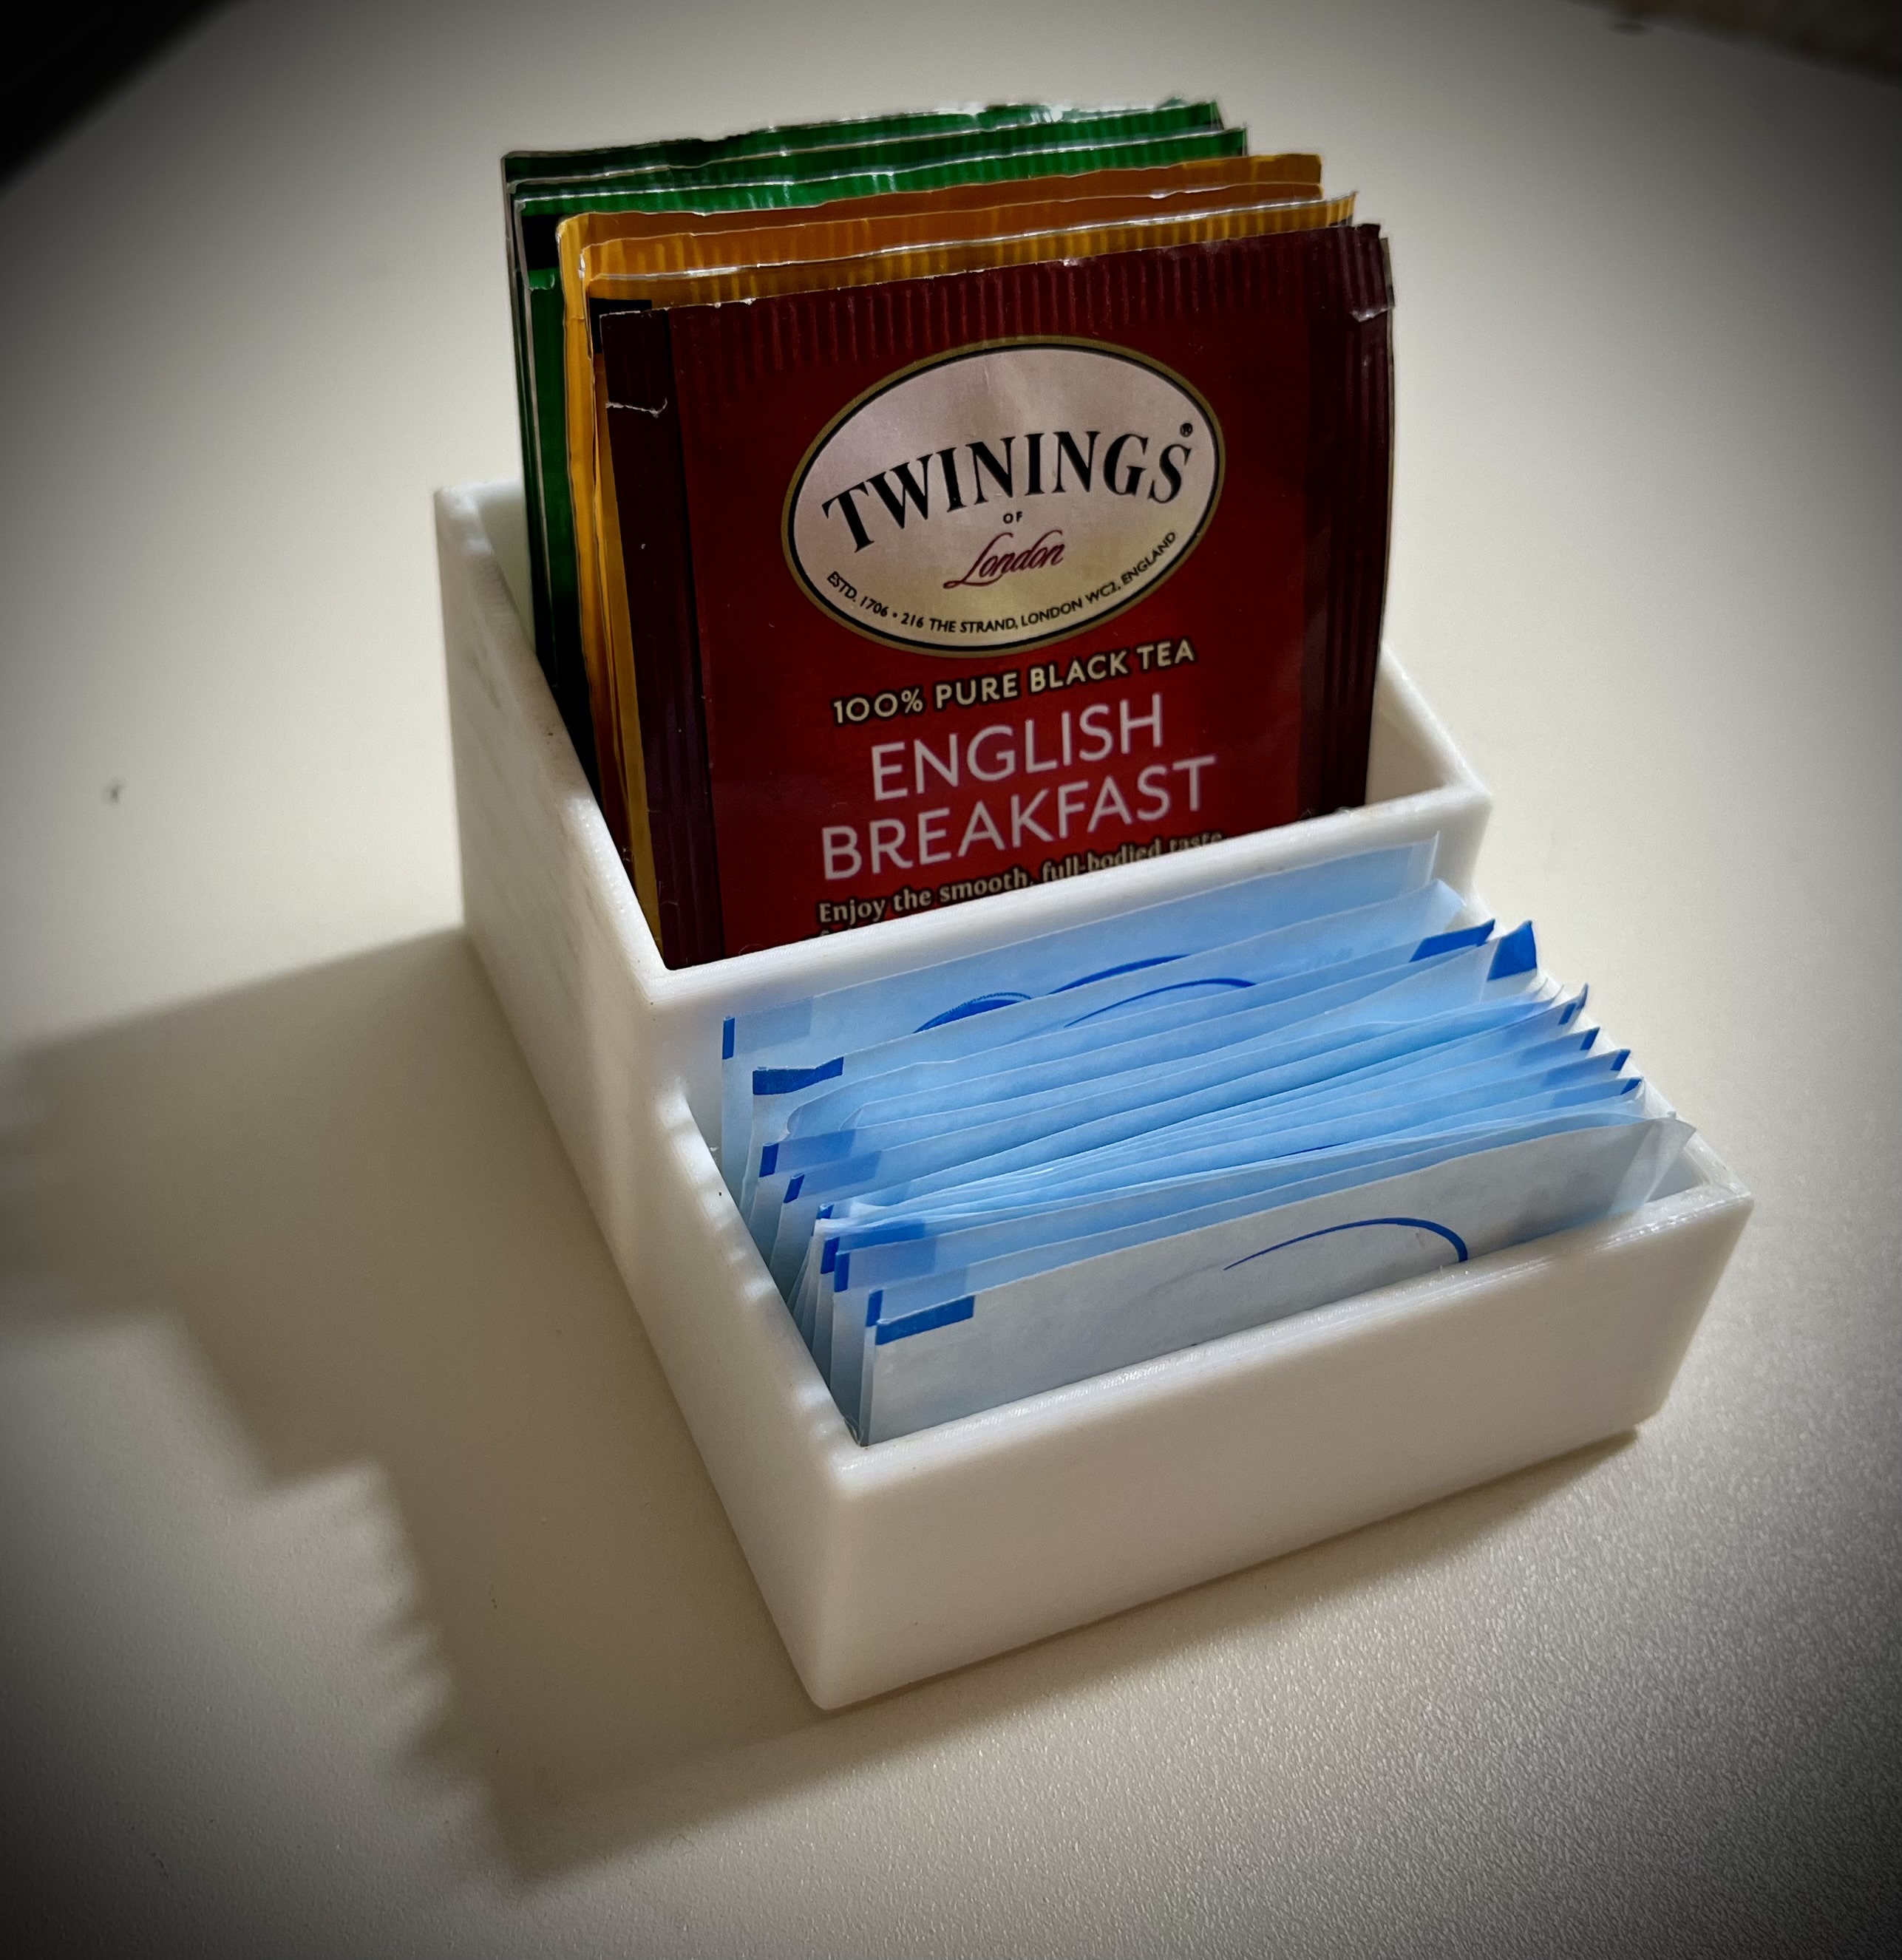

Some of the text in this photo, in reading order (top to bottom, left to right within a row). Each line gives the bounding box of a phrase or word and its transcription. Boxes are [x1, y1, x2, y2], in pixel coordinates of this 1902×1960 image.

[942, 529, 1065, 589] London
[1002, 511, 1024, 525] OF
[826, 571, 857, 602] ESTD.
[859, 596, 889, 617] 1706
[900, 613, 925, 628] 216
[929, 618, 957, 633] THE
[960, 618, 1019, 633] STRAND,
[1021, 598, 1083, 627] LONDON
[1121, 531, 1177, 586] ENGLAND
[833, 638, 1195, 724] 100% PURE BLACK TEA
[871, 693, 1164, 801] ENGLISH
[821, 755, 1217, 880] BREAKFAST
[819, 899, 886, 924] Enjoy
[893, 888, 932, 912] the
